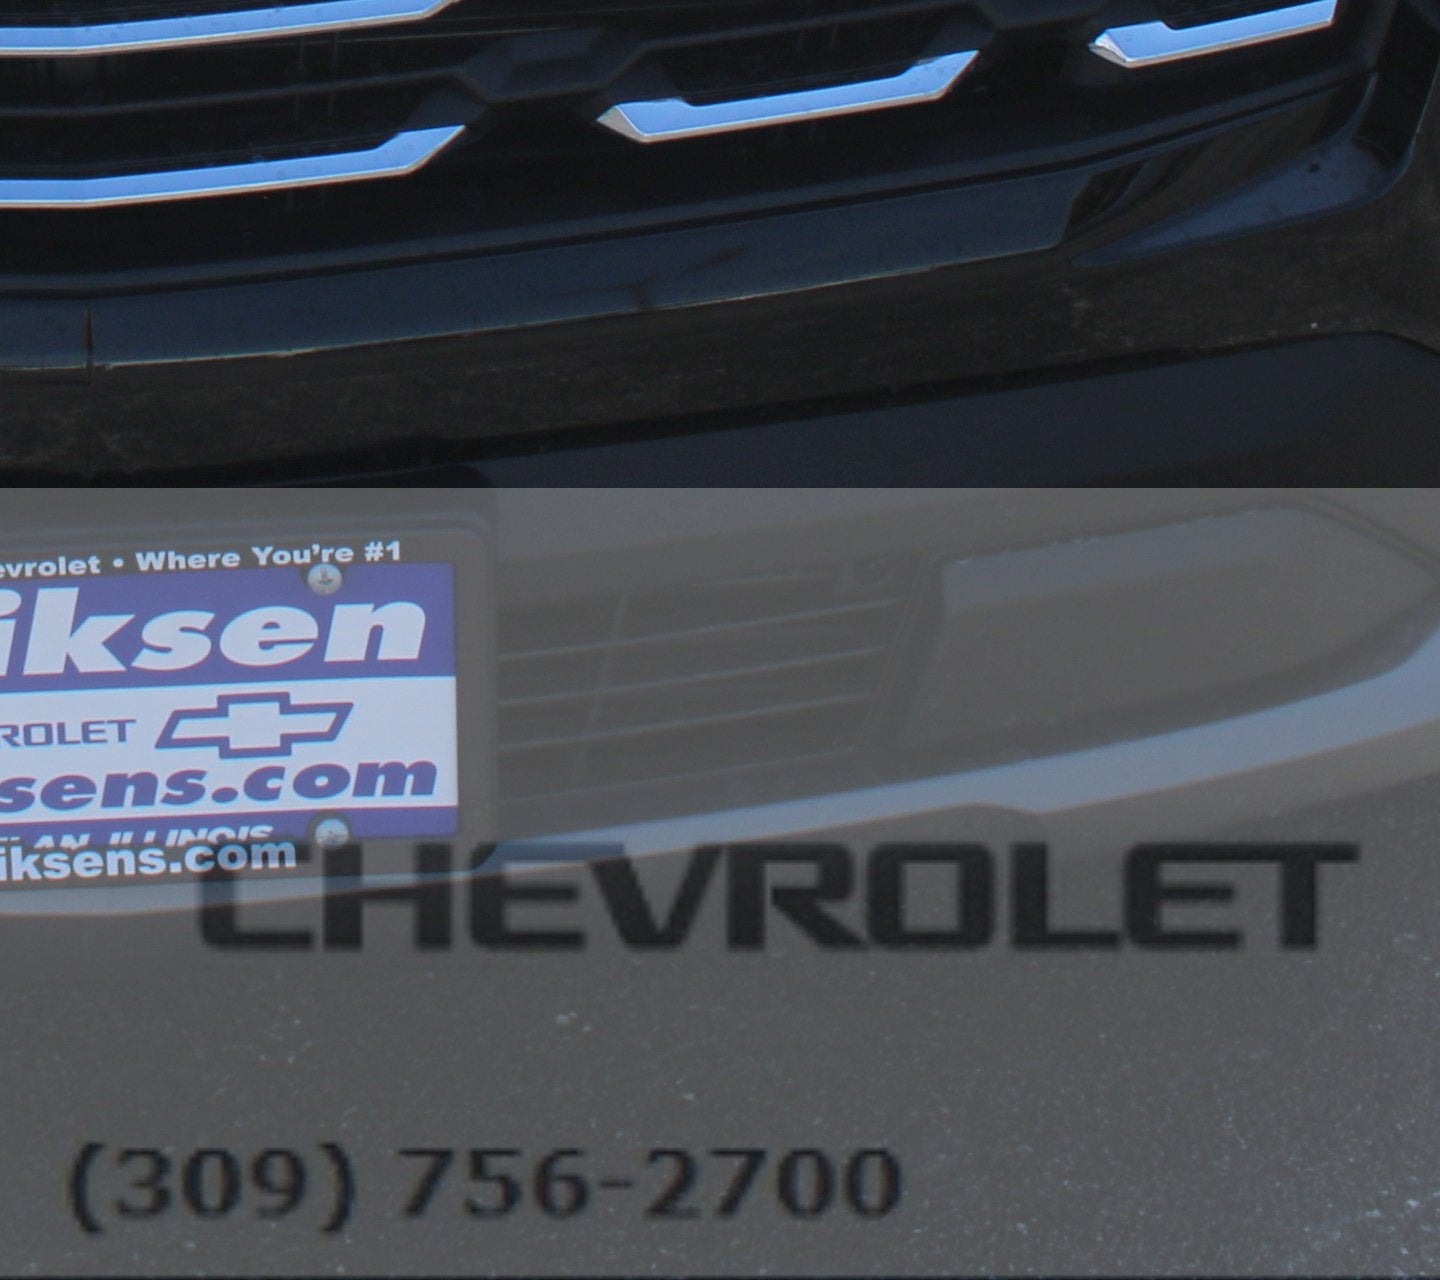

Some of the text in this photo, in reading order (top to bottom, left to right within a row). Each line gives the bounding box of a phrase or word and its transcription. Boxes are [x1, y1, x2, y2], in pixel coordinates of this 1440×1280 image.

[136, 549, 240, 571] Where
[252, 543, 354, 565] You're
[364, 540, 401, 561] #1
